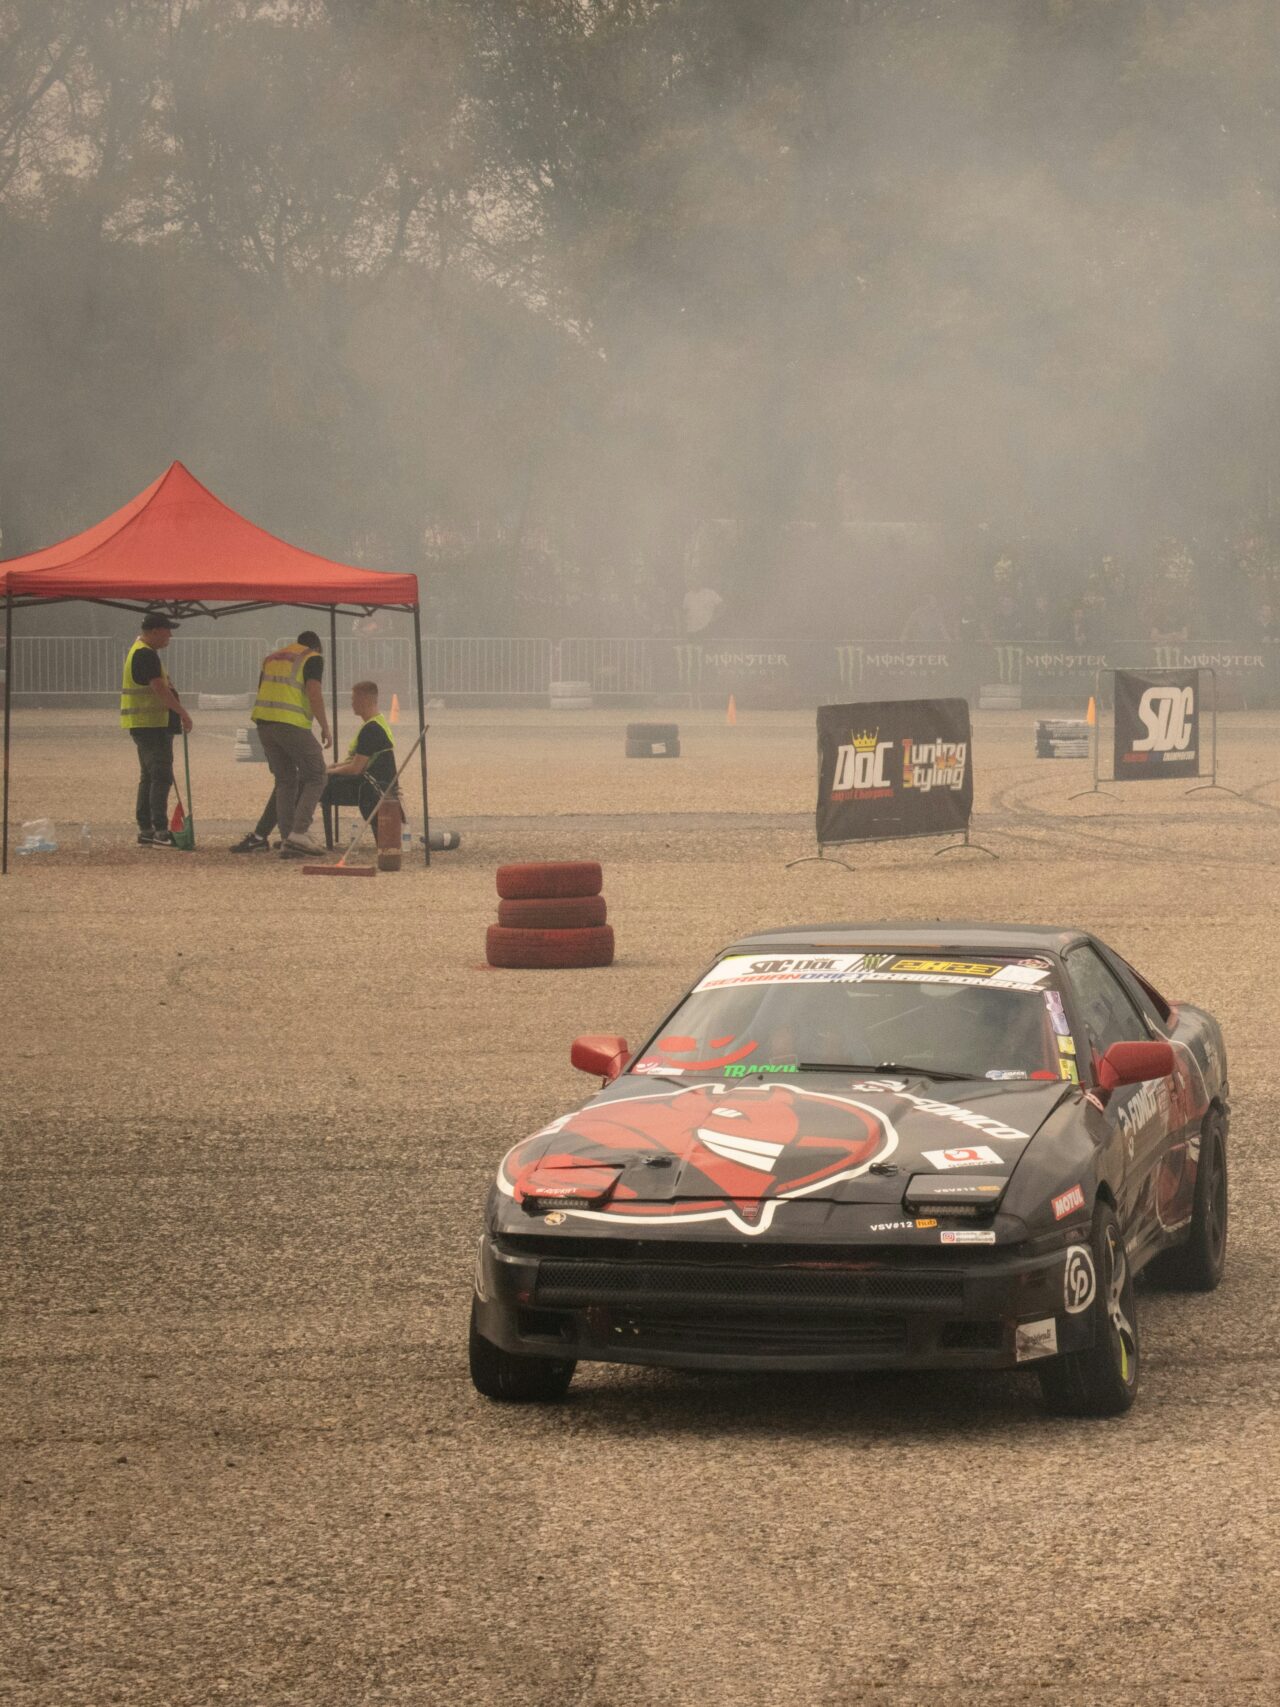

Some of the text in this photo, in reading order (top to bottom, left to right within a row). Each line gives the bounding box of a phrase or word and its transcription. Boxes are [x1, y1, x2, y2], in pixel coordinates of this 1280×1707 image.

[705, 652, 789, 668] MONSTER
[866, 652, 949, 668] MONSTER
[1024, 653, 1107, 669] MONSTER
[1183, 653, 1265, 668] MONSTER
[1132, 686, 1194, 751] SDC
[902, 738, 967, 768] Tuning
[903, 764, 965, 793] Styling
[893, 1092, 1030, 1139] FOMCO
[1055, 1188, 1085, 1217] MOTUL
[870, 1221, 914, 1231] VSV#12
